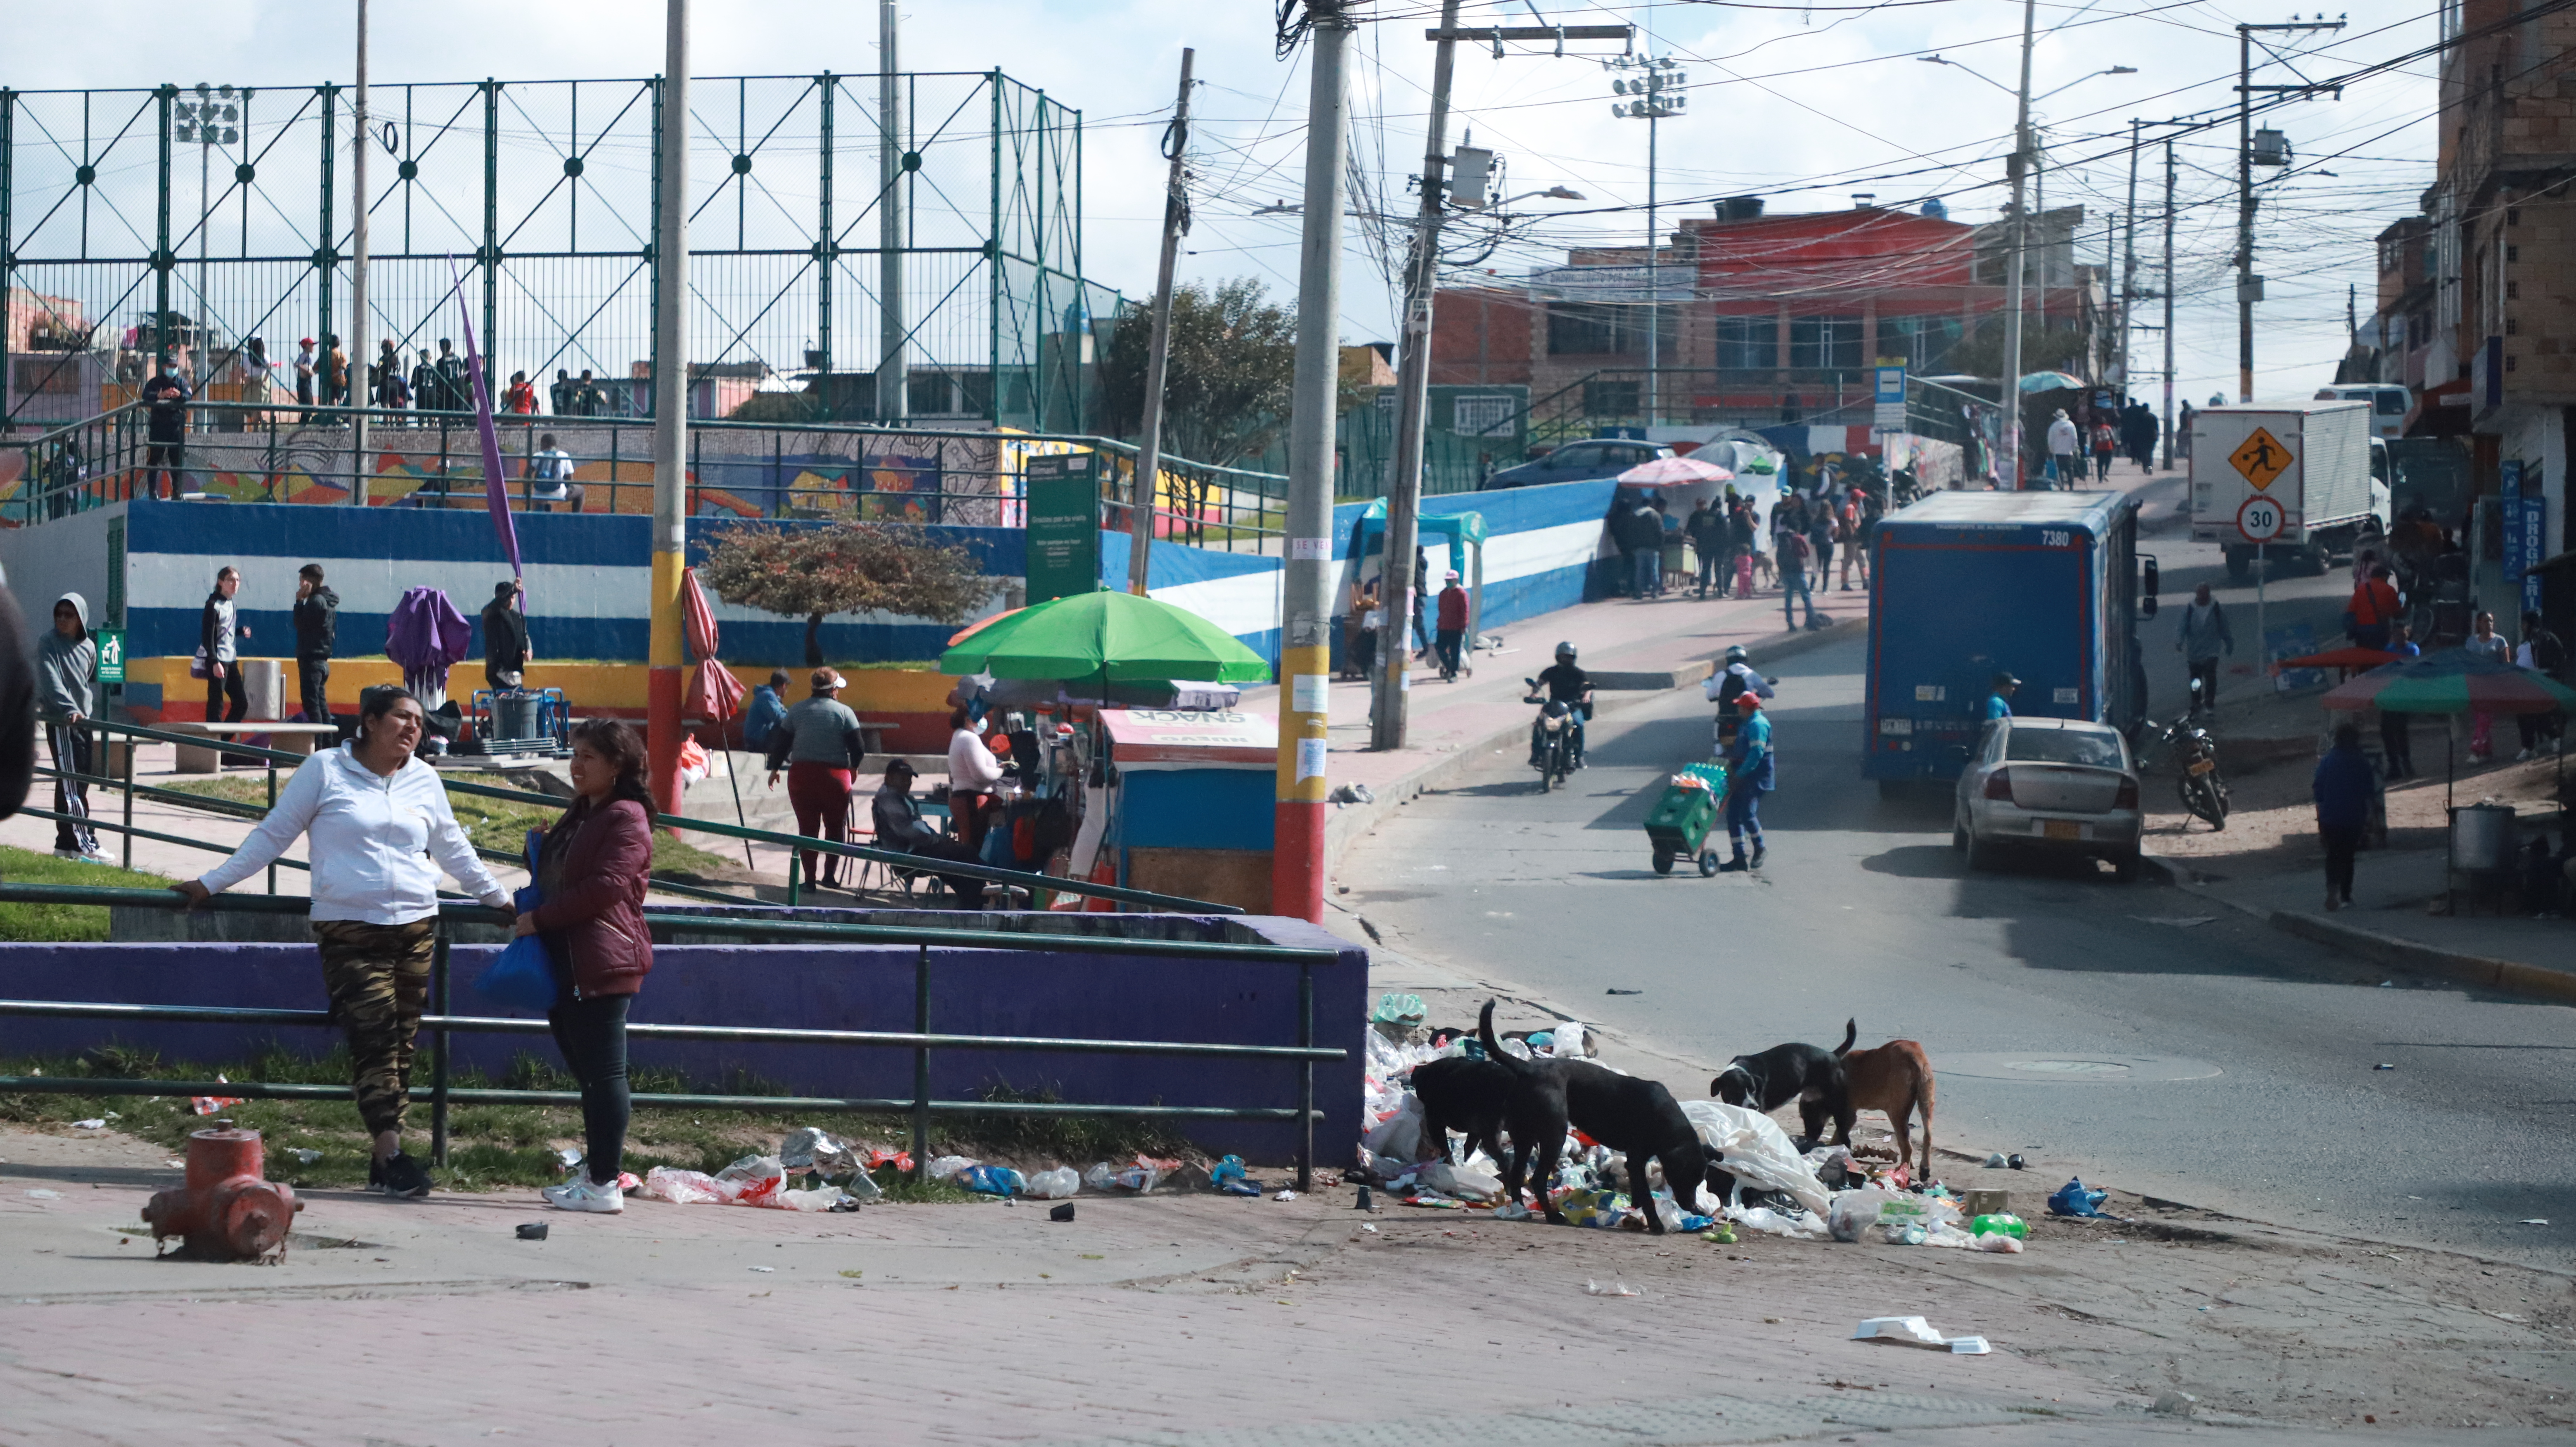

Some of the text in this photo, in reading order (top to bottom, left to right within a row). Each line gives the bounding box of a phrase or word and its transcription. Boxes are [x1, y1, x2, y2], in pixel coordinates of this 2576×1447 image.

[2250, 511, 2272, 528] 30
[1296, 540, 1308, 549] SE
[2042, 530, 2069, 547] 7380
[2526, 511, 2539, 609] DROGUERI
[1131, 711, 1246, 723] SNACK
